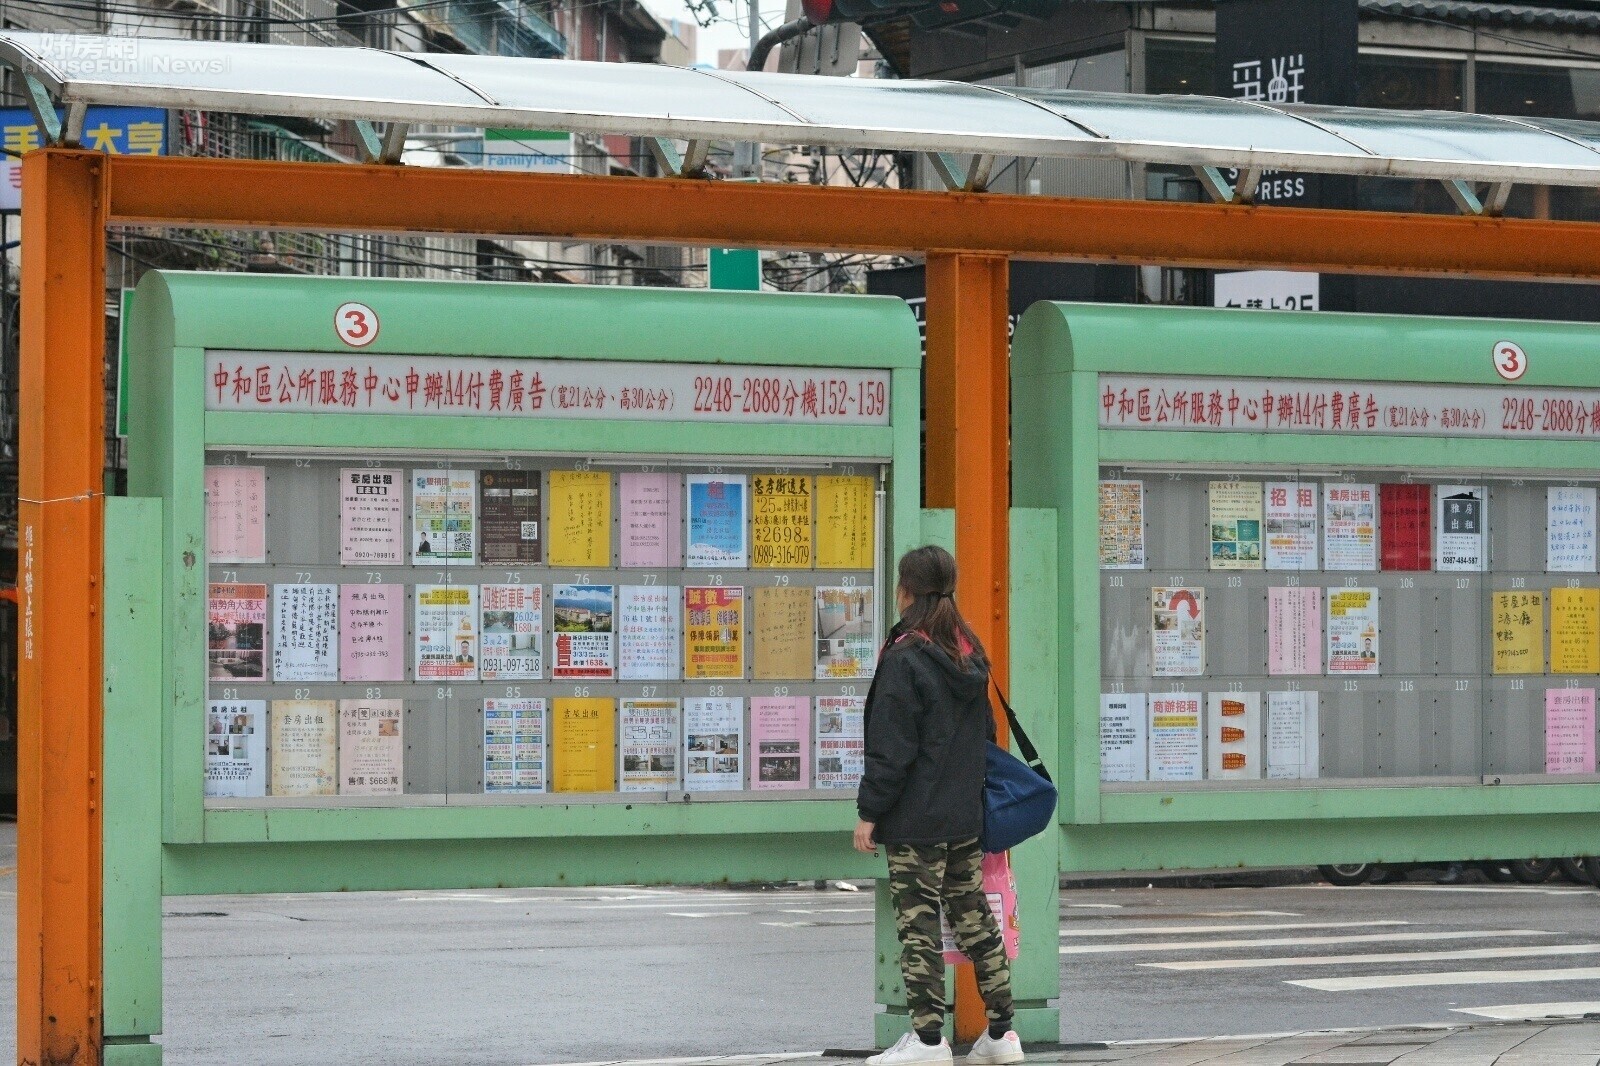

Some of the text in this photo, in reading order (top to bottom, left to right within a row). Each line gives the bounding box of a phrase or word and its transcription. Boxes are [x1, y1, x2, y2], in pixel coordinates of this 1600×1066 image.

[488, 151, 568, 168] FamilyMart
[344, 310, 369, 338] 3
[1500, 347, 1519, 372] 3
[840, 466, 855, 477] 70
[1270, 488, 1313, 507] 招租
[1329, 489, 1371, 502] 套房出租
[1450, 503, 1475, 515] 雅房
[1451, 518, 1474, 530] 出租
[754, 544, 810, 564] 0989-316-079
[222, 571, 239, 583] 71
[295, 572, 312, 584] 72
[366, 572, 382, 584] 73
[437, 572, 452, 584] 74
[505, 572, 521, 584] 75
[574, 573, 590, 584] 76
[642, 574, 658, 586] 77
[707, 574, 723, 586] 78
[774, 575, 789, 587] 79
[841, 576, 856, 587] 80
[1109, 576, 1124, 587] 101
[1169, 576, 1184, 587] 102
[1227, 576, 1242, 588] 103
[1286, 576, 1300, 587] 104
[1344, 577, 1358, 588] 105
[1400, 577, 1414, 589] 106
[1511, 577, 1525, 588] 108
[1456, 578, 1470, 589] 107
[1566, 578, 1580, 589] 109
[483, 658, 540, 672] 0931-097-518
[1110, 682, 1125, 694] 111
[1170, 682, 1185, 693] 112
[1228, 682, 1243, 693] 113
[1286, 681, 1300, 692] 114
[1344, 680, 1358, 691] 115
[1400, 680, 1414, 692] 116
[1455, 680, 1469, 691] 117
[1510, 679, 1524, 690] 118
[1565, 679, 1579, 689] 119
[223, 688, 239, 700] 81
[294, 688, 311, 700] 82
[366, 687, 382, 699] 83
[437, 687, 453, 699] 84
[505, 686, 521, 698] 85
[574, 686, 590, 698] 86
[642, 685, 657, 698] 87
[709, 685, 724, 697] 88
[773, 686, 789, 697] 89
[841, 685, 856, 697] 90
[1153, 700, 1198, 713] 商辦招租
